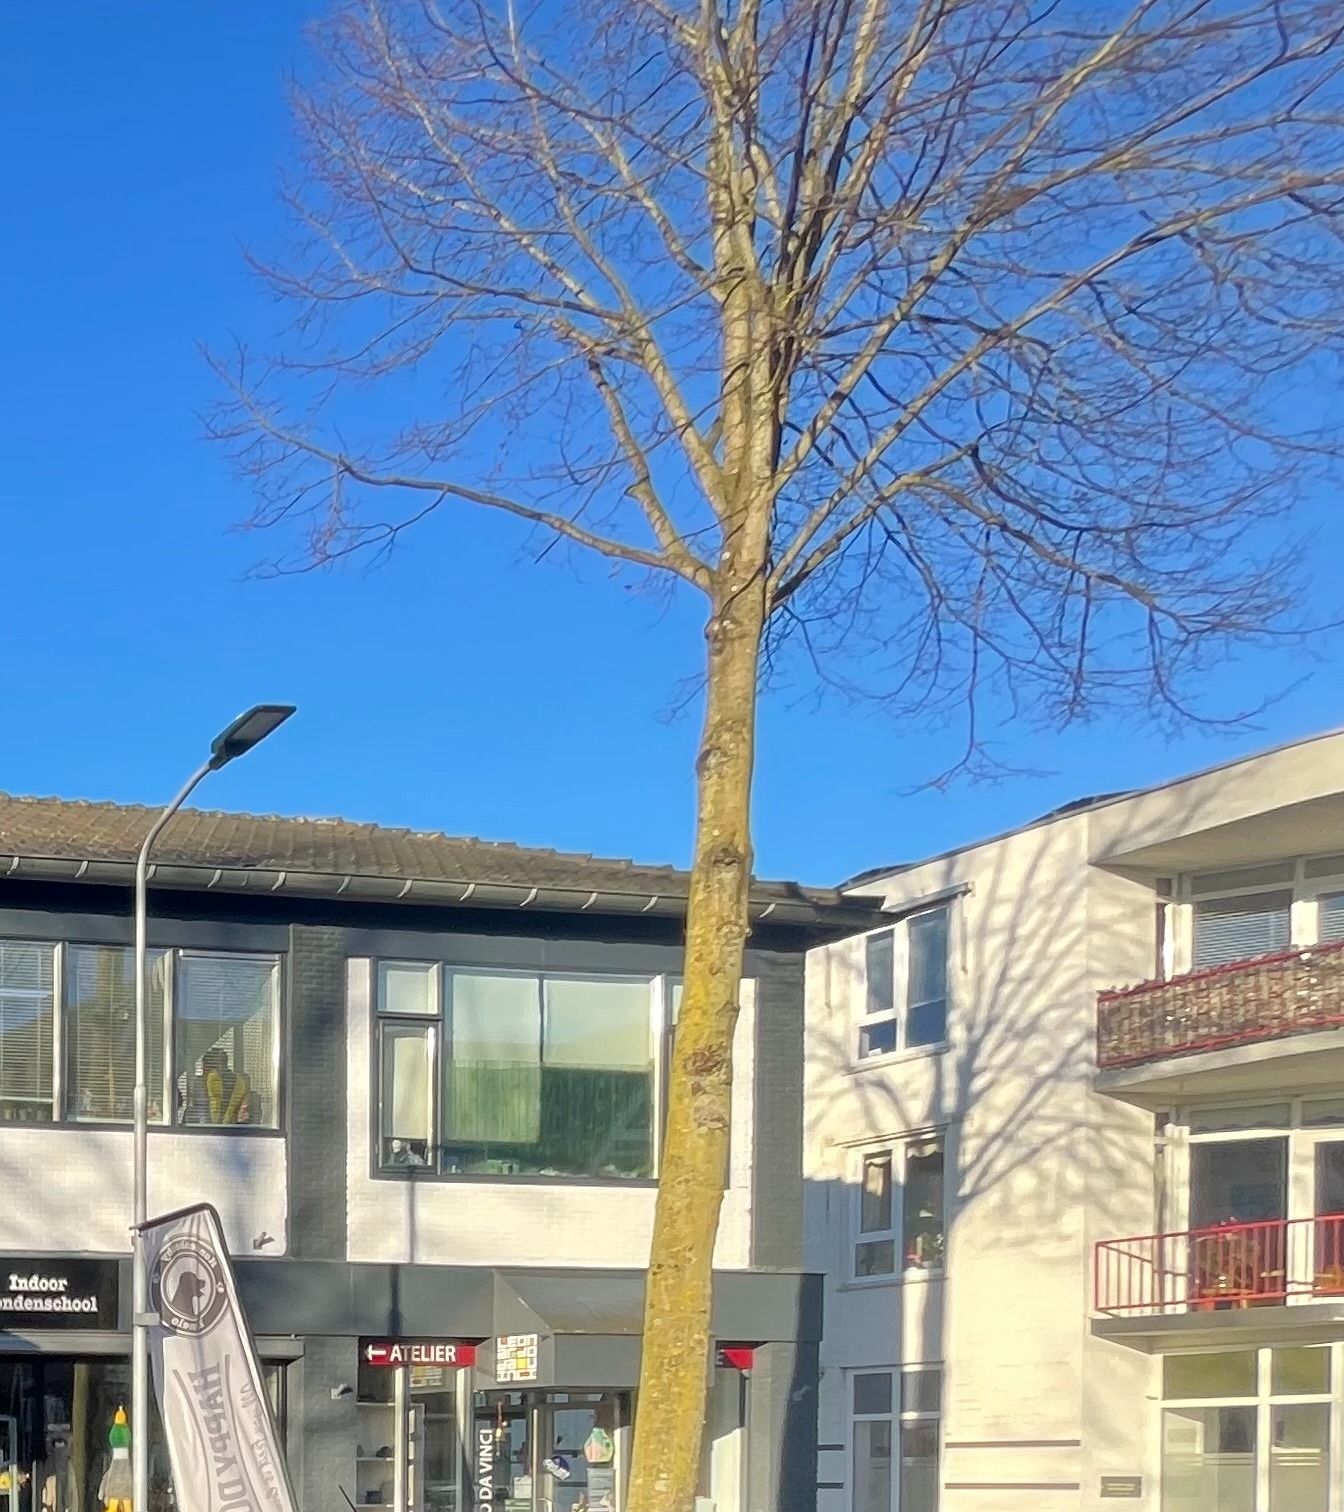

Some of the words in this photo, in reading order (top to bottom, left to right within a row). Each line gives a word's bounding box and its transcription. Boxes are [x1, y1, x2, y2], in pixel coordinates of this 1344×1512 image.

[8, 1273, 68, 1292] Indoor
[388, 1345, 457, 1362] ATELIER
[479, 1429, 493, 1474] VINCI
[479, 1475, 493, 1500] DA
